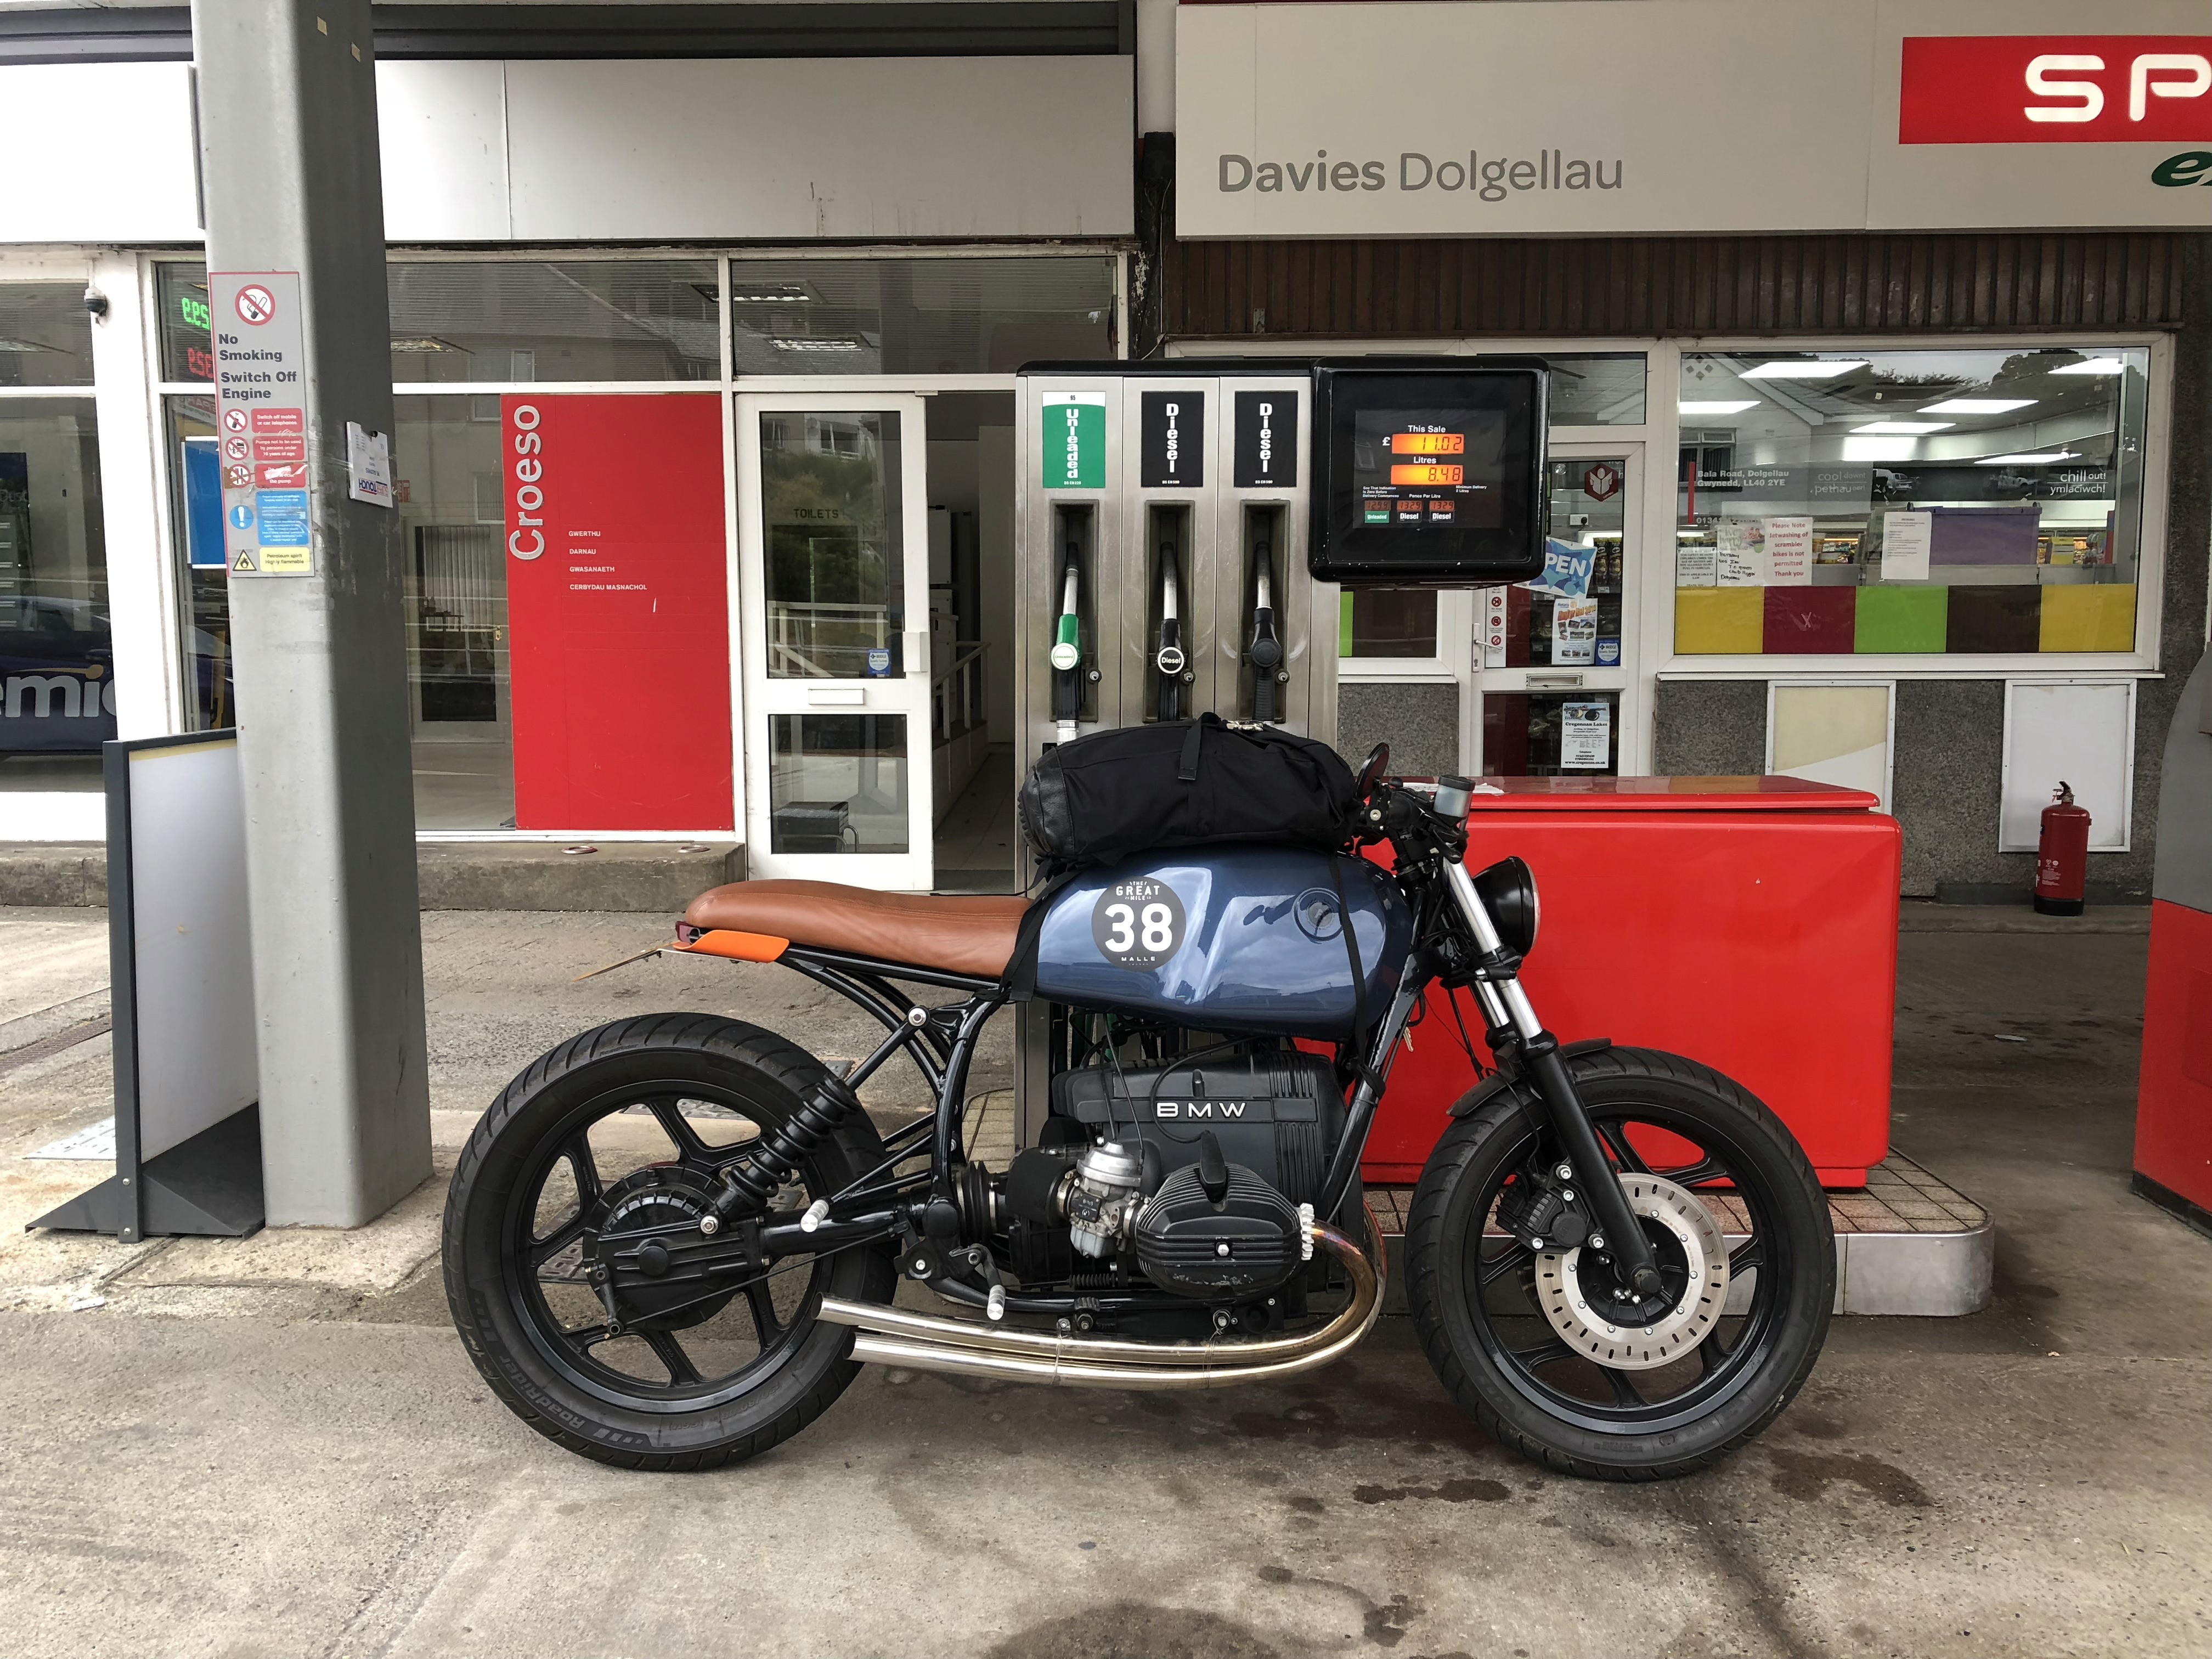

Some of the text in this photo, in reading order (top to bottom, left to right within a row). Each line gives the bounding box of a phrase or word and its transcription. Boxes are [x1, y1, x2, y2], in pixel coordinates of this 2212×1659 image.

[1219, 149, 1622, 202] Davies Dolgellau
[2151, 151, 2212, 187] e
[218, 334, 238, 345] No
[219, 349, 282, 362] Smoking
[221, 371, 297, 383] Switch Off
[222, 388, 272, 400] Engine
[1066, 409, 1079, 478] Unleaded
[1166, 403, 1179, 473] Diesel
[1259, 403, 1272, 473] Diesel
[1382, 436, 1462, 450] £ 11.02
[1428, 467, 1461, 482] 8.48
[1818, 471, 1842, 481] cool
[2060, 469, 2086, 482] chill
[358, 478, 377, 492] TOUCH
[509, 405, 545, 560] Croeso
[2050, 483, 2106, 496] ymlaciwch!
[1814, 485, 1851, 495] pethau
[793, 509, 839, 518] TOILETS
[1116, 885, 1160, 896] GREAT
[1105, 903, 1172, 952] 38
[1156, 1102, 1246, 1118] BMW
[499, 1356, 586, 1429] RoadRider
